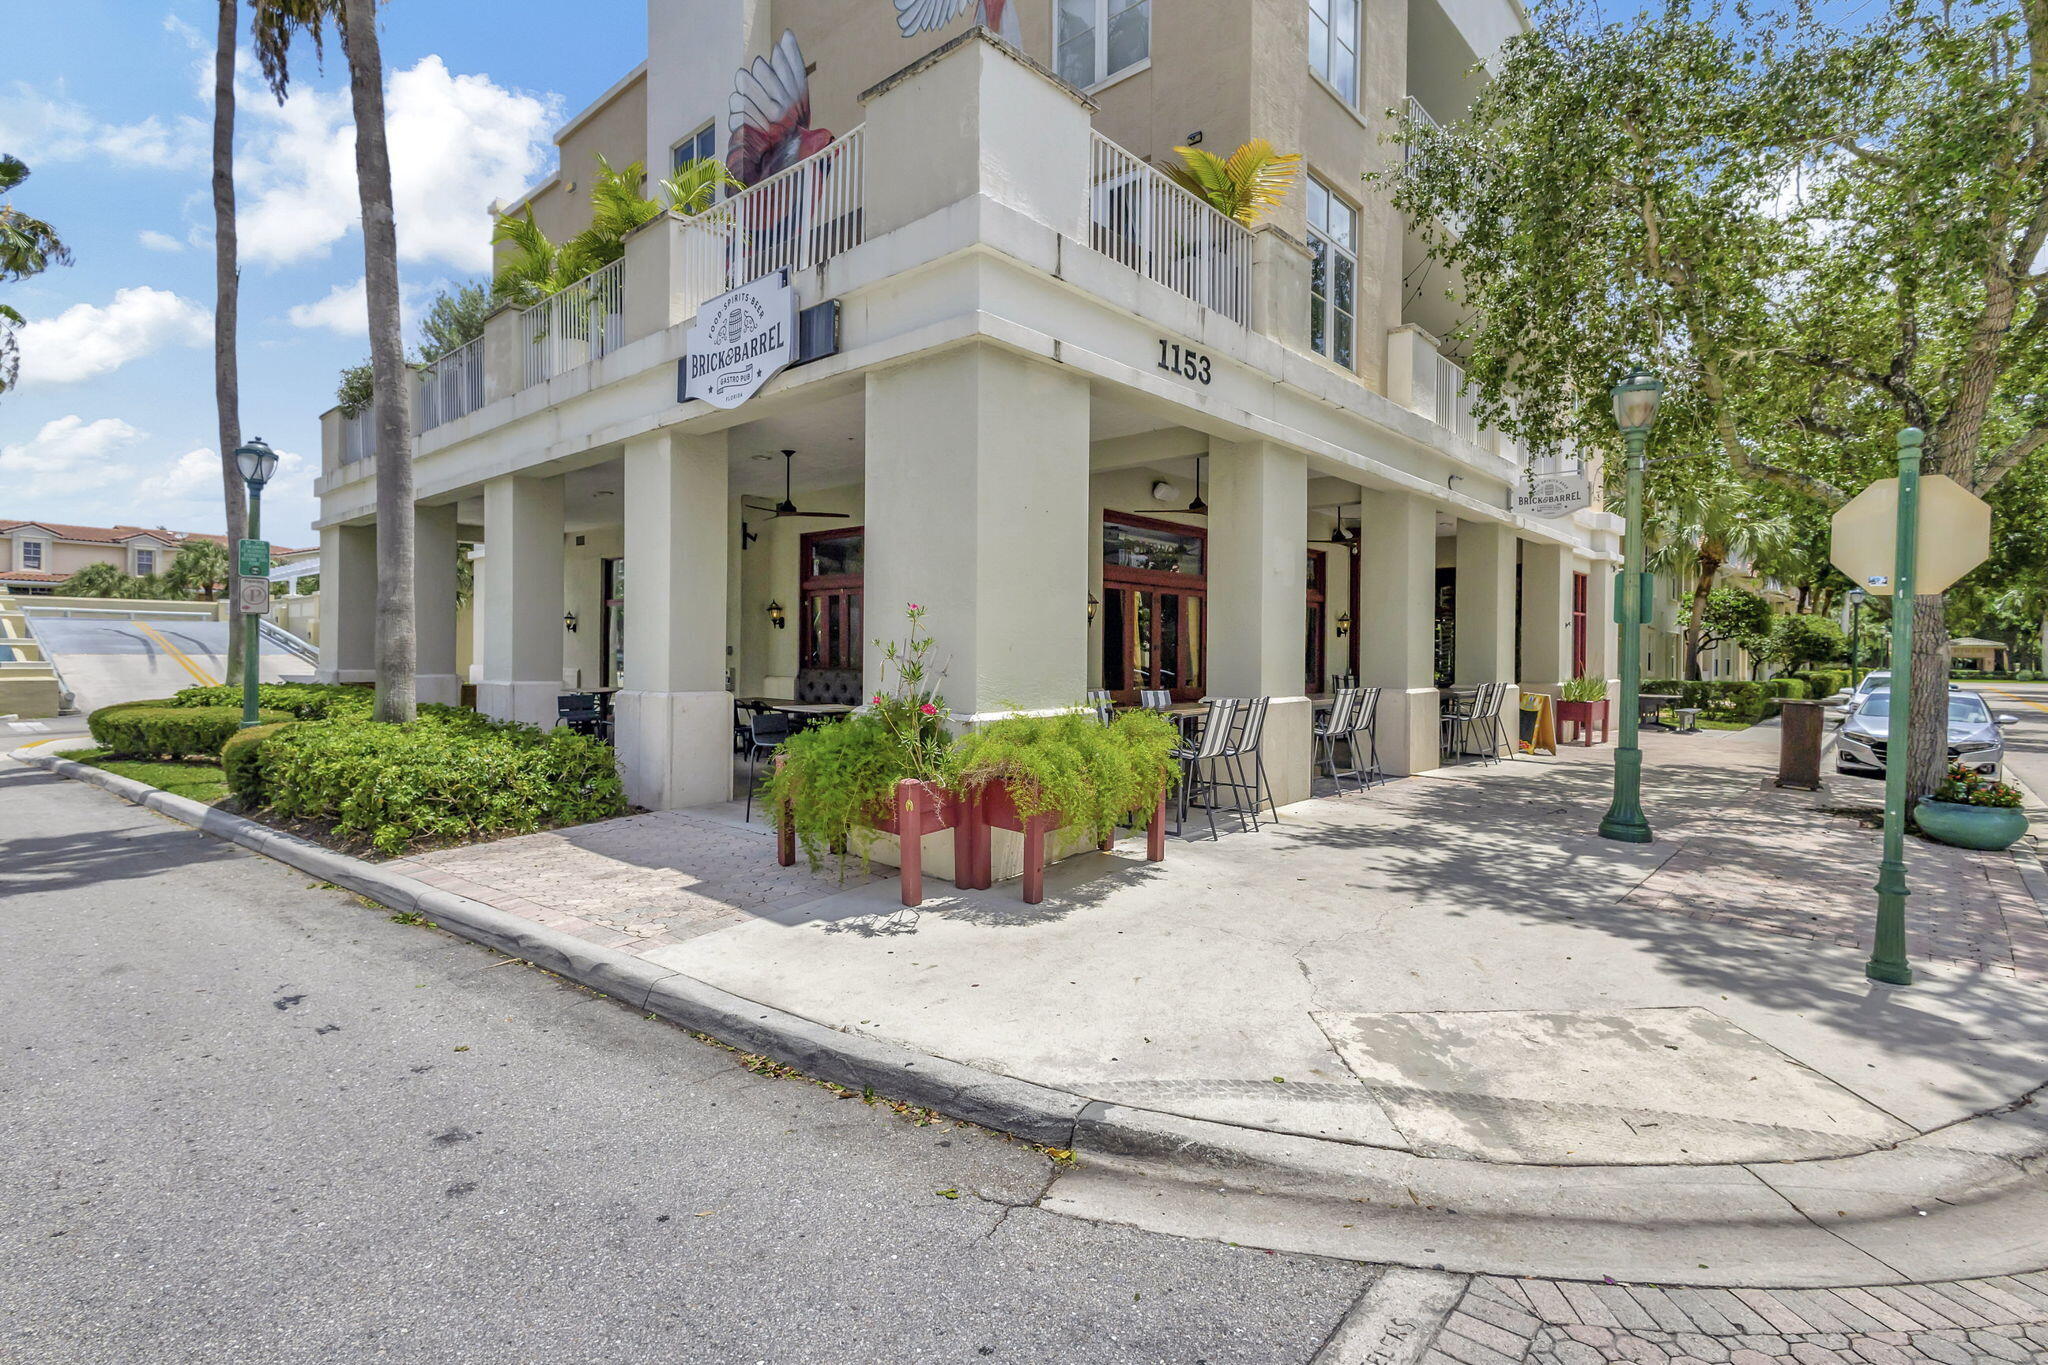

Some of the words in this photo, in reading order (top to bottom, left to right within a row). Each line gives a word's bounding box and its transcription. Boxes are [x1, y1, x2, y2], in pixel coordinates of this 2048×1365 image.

[708, 311, 722, 339] FOOD
[723, 293, 749, 311] SPIRITS
[750, 296, 765, 320] BEER
[692, 322, 784, 379] BRICK&BARREL
[1158, 339, 1211, 385] 1153
[720, 375, 740, 386] GASTRO
[740, 373, 751, 383] PUB
[725, 393, 742, 401] FLORIDA
[1519, 491, 1581, 505] BRICK&BARREL
